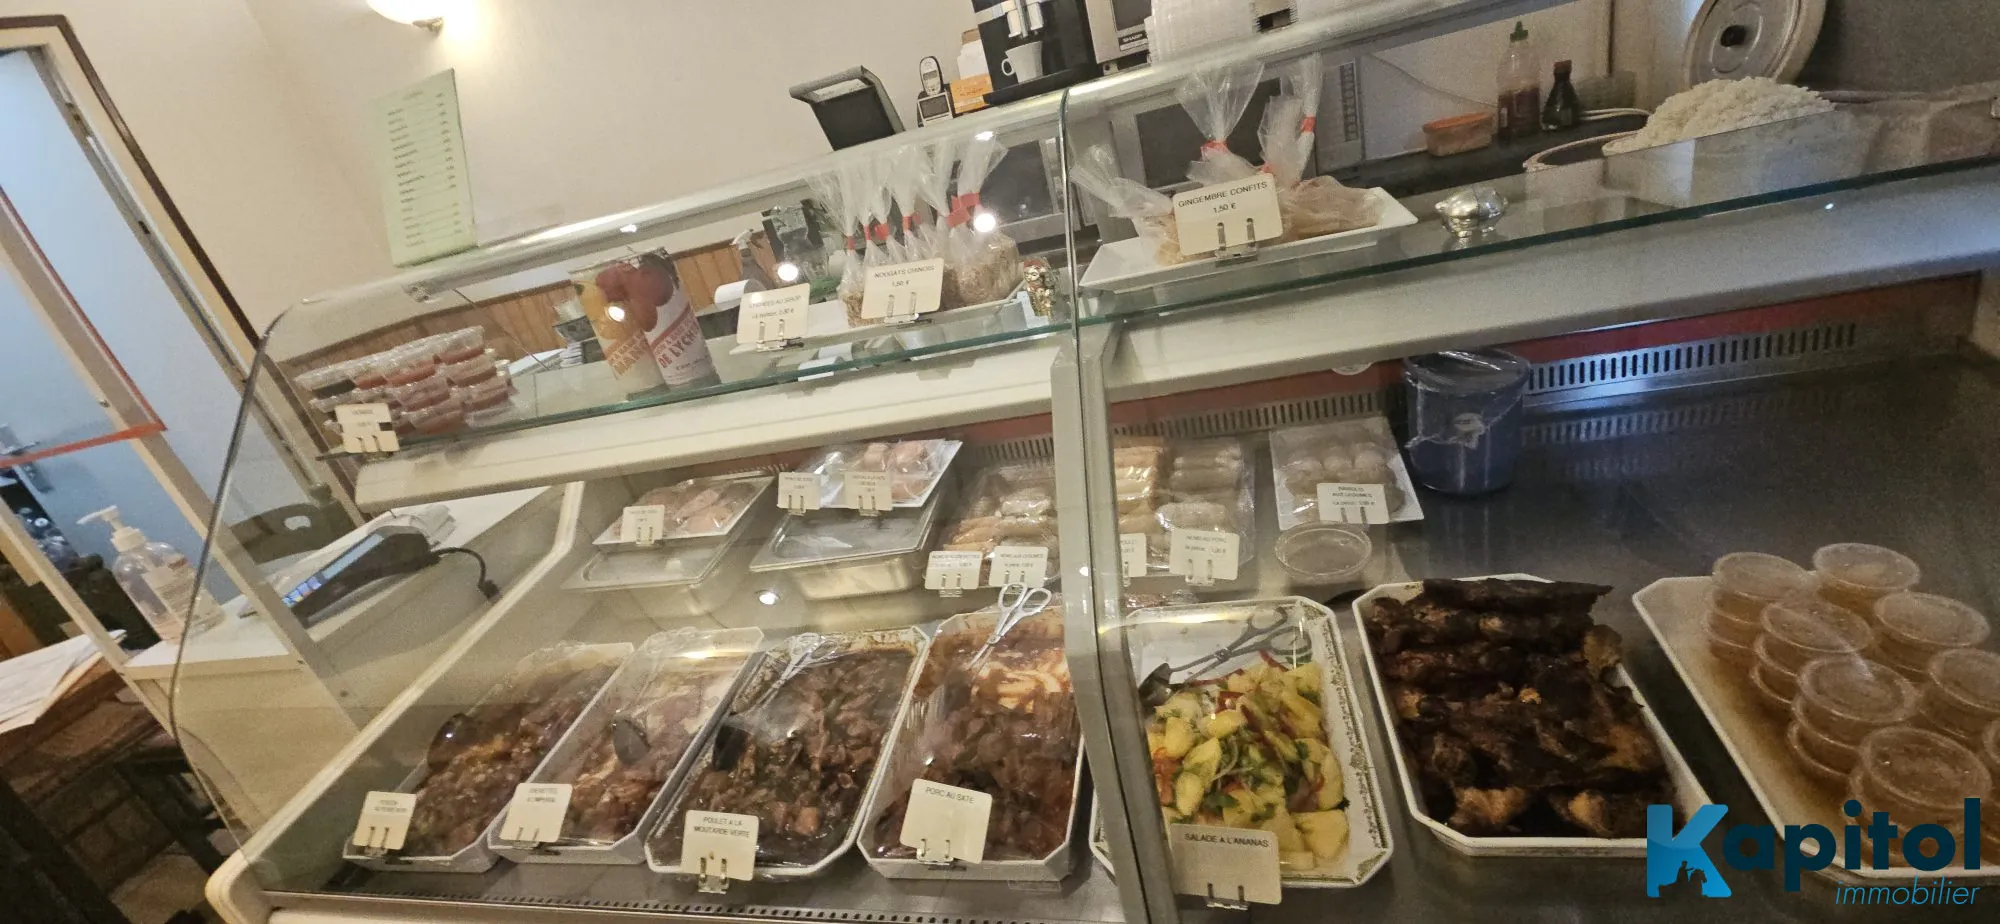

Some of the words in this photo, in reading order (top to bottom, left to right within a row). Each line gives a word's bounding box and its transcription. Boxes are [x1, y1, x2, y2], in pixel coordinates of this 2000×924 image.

[1122, 33, 1144, 43] SHARP
[1178, 191, 1227, 208] GINGEMBRE
[1230, 181, 1268, 196] CONFITS
[1213, 203, 1229, 214] 1,50
[874, 269, 906, 279] NOUGATS
[907, 265, 936, 275] CHINOIS
[925, 786, 945, 797] PORC
[946, 791, 955, 799] AU
[703, 816, 727, 825] POULET
[694, 826, 729, 836] MOUTARDE
[730, 829, 750, 838] VERTE
[1184, 833, 1218, 843] SALADE
[1227, 838, 1269, 848] L'ANANAS
